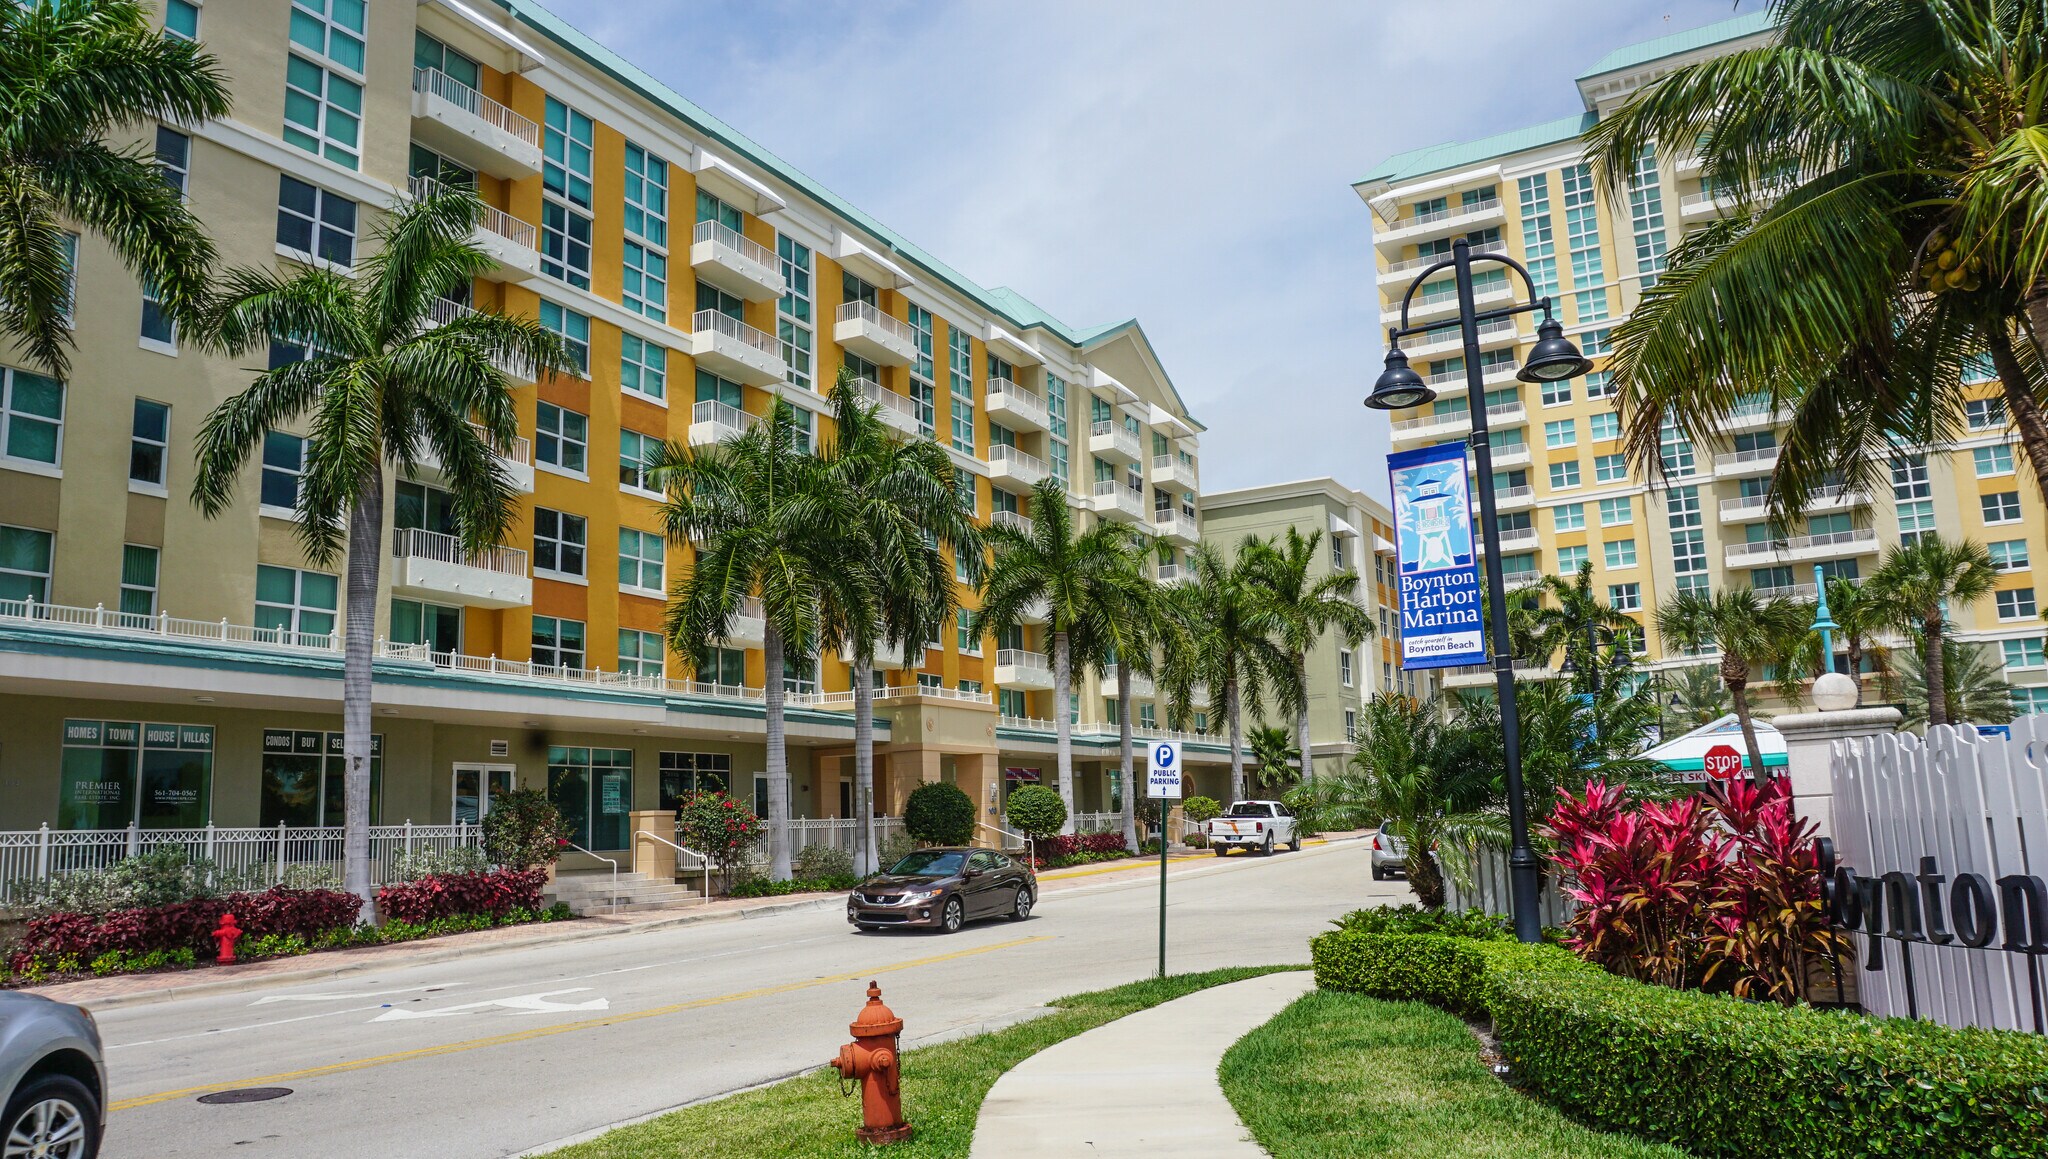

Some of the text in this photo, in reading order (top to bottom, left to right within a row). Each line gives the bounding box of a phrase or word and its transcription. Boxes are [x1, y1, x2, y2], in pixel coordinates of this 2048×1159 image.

[1401, 572, 1475, 593] Boynton
[1402, 587, 1476, 610] Harbor
[1403, 607, 1478, 628] Marina
[1409, 640, 1475, 653] Boynton Beach
[1424, 636, 1446, 645] yourself
[67, 726, 210, 744] HOMES TOWN HOUSE VILLAS
[265, 735, 345, 749] CONDOS BUY SEL
[1160, 748, 1171, 765] P
[1706, 755, 1740, 770] STOP
[75, 781, 121, 790] PREMIER
